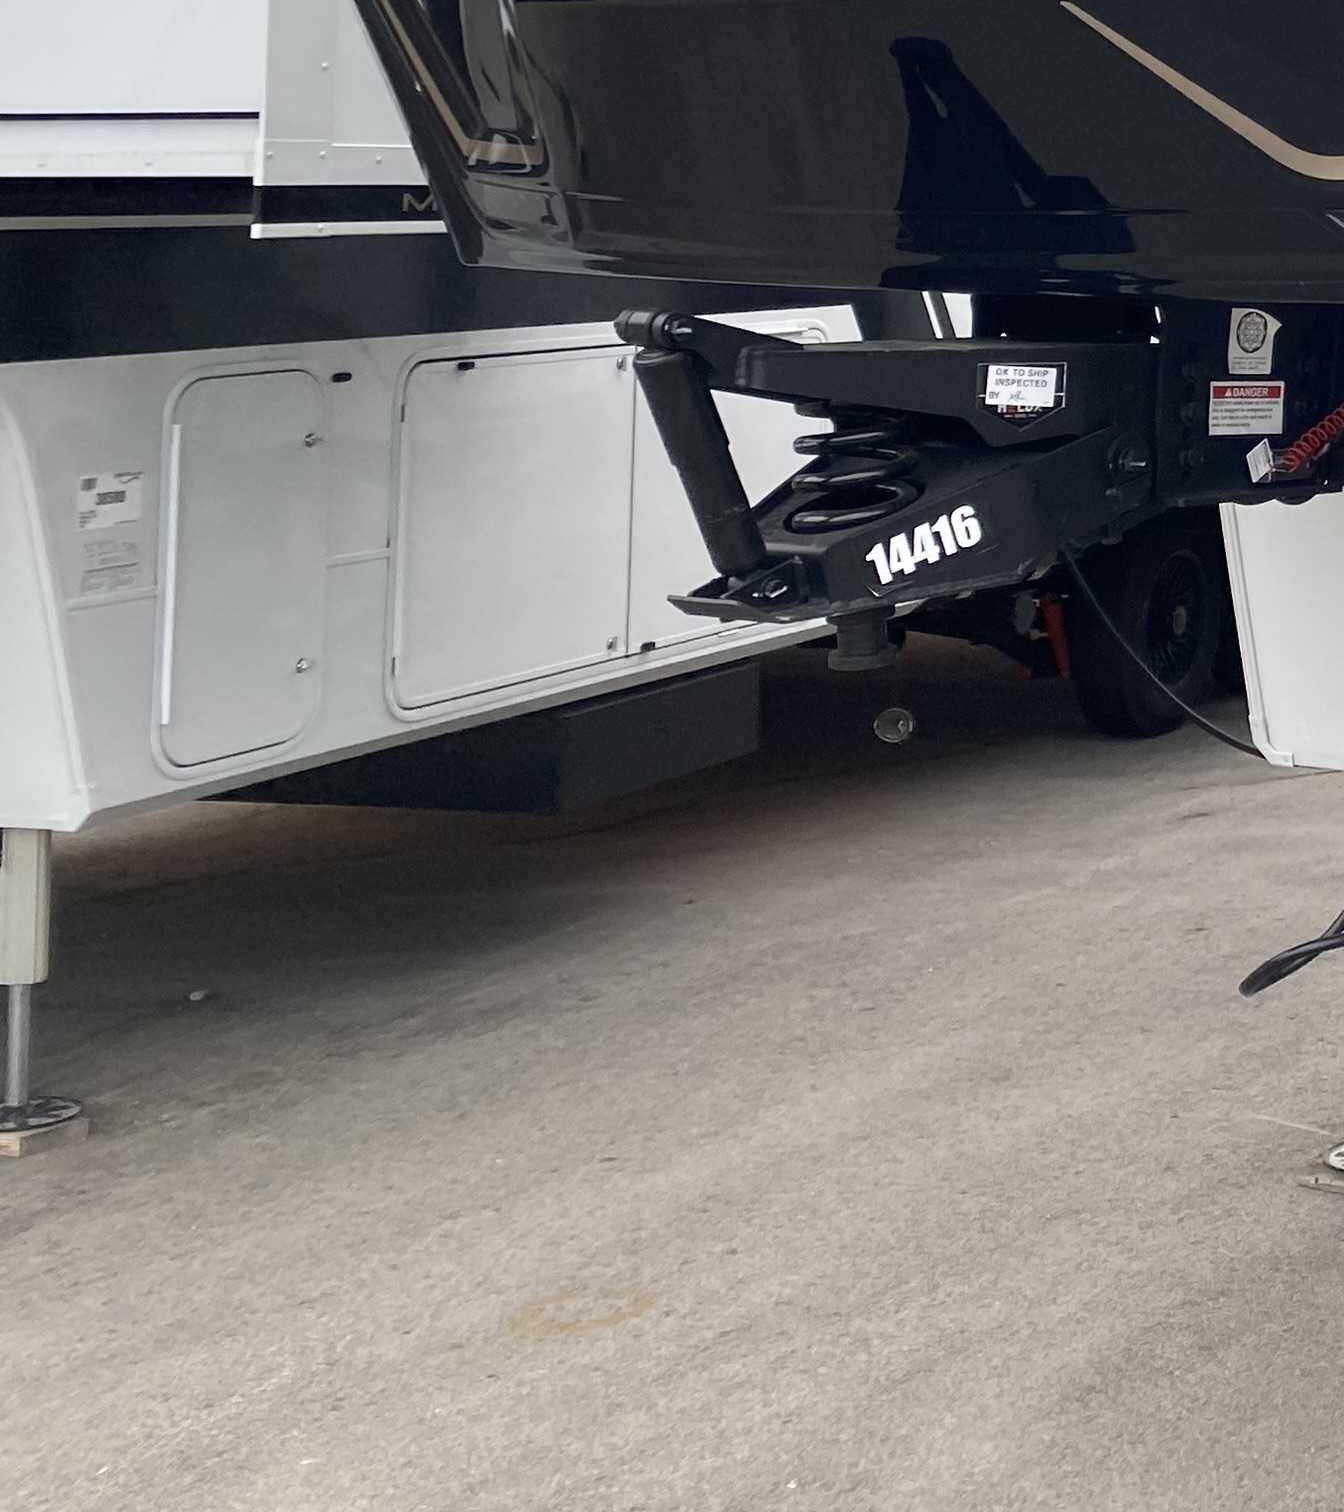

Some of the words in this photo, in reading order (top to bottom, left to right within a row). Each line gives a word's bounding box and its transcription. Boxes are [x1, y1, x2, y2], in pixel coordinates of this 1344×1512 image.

[995, 368, 1009, 376] OK
[1013, 369, 1025, 377] TO
[1027, 369, 1049, 378] SHIP
[995, 379, 1048, 387] INSPECTED
[988, 391, 1000, 399] BY
[1232, 387, 1269, 397] DANGER
[865, 505, 982, 585] 14416
